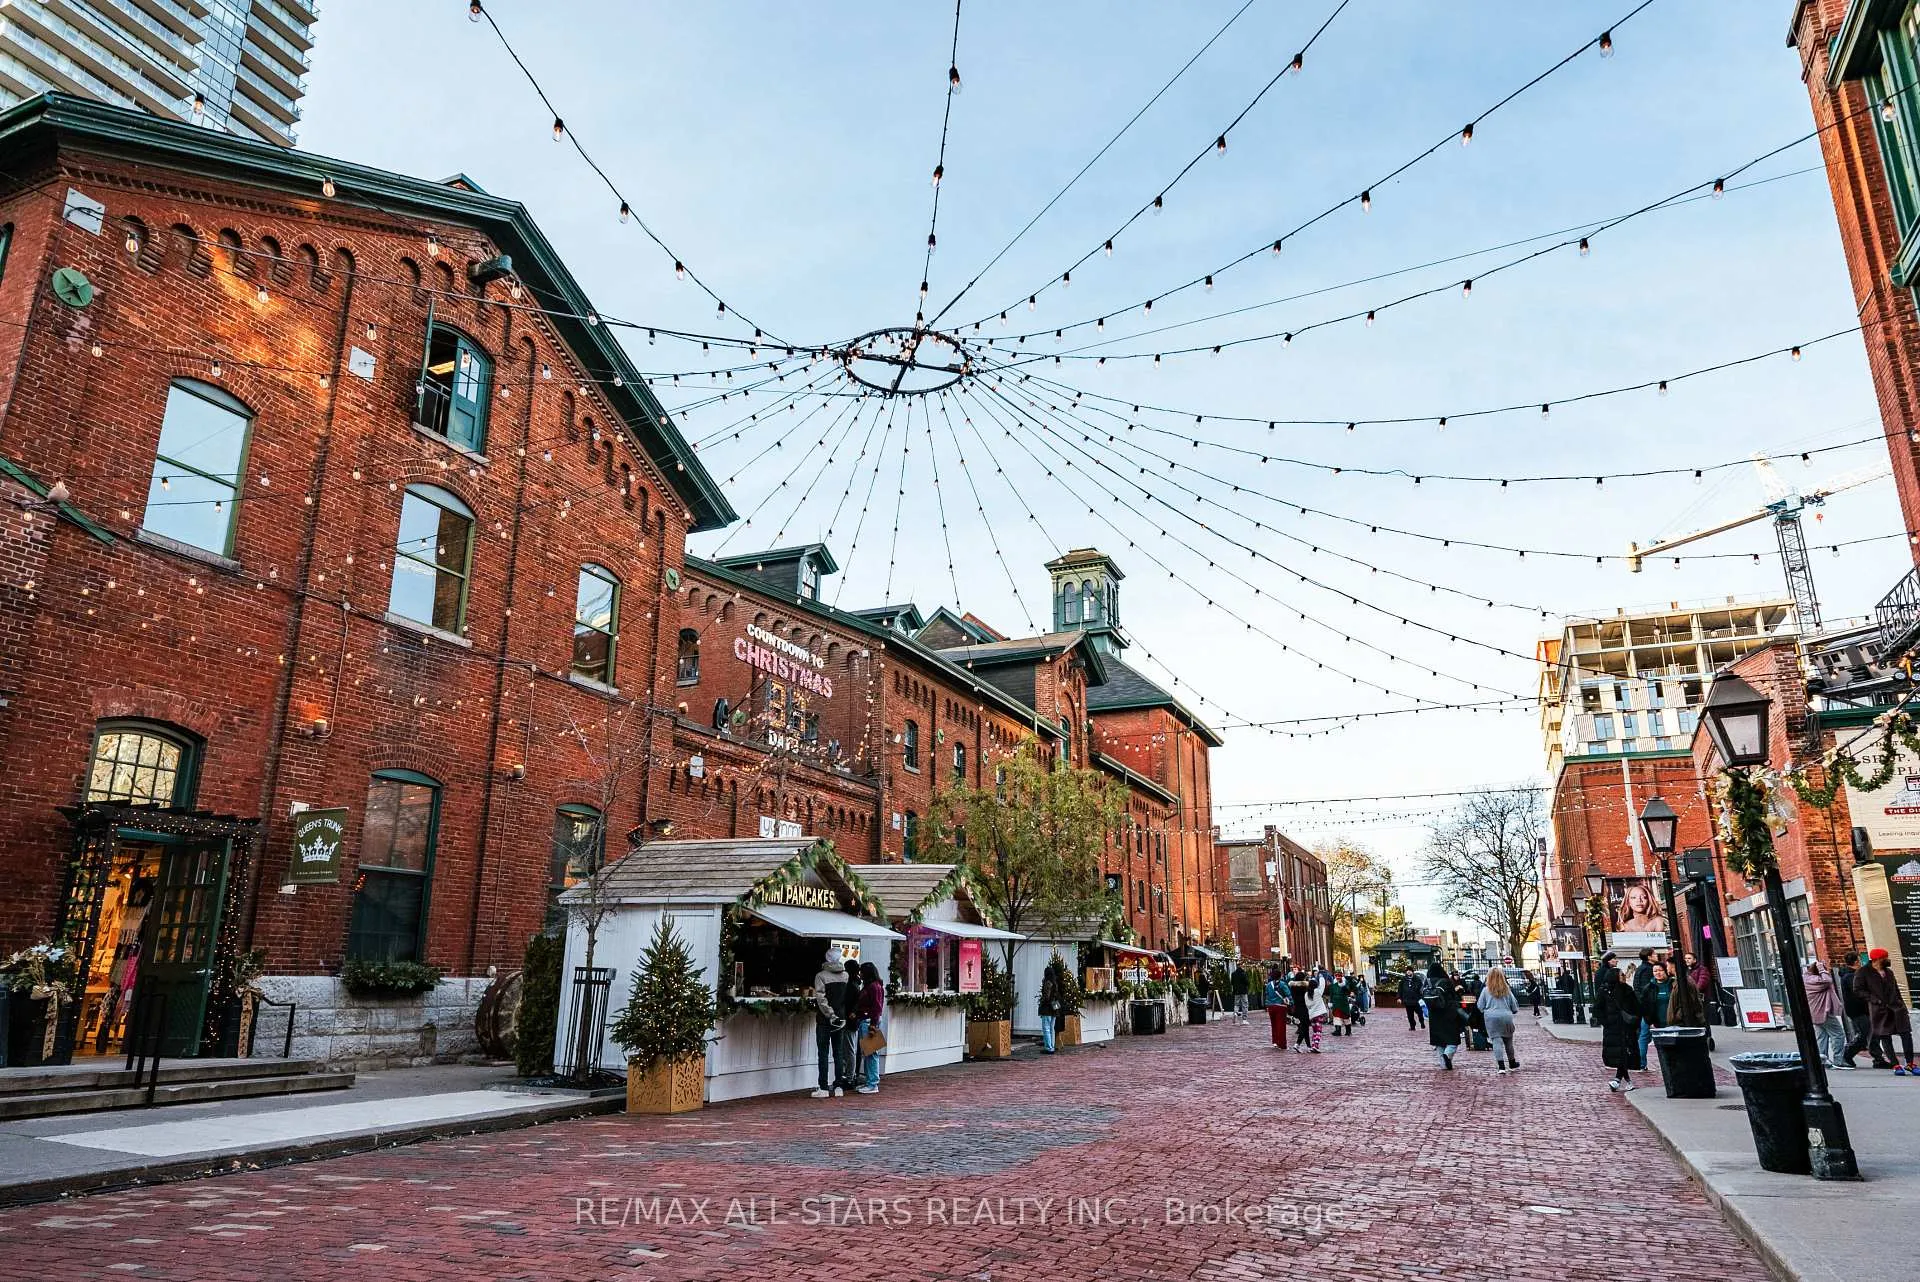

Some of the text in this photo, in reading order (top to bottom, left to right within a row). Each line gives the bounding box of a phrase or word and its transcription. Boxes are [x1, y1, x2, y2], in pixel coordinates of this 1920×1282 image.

[747, 623, 825, 669] COUNTDOWN TO
[734, 637, 833, 698] CHRISTMAS
[297, 818, 344, 838] QUEEN'S TRUNK
[786, 884, 835, 909] PANCAKES
